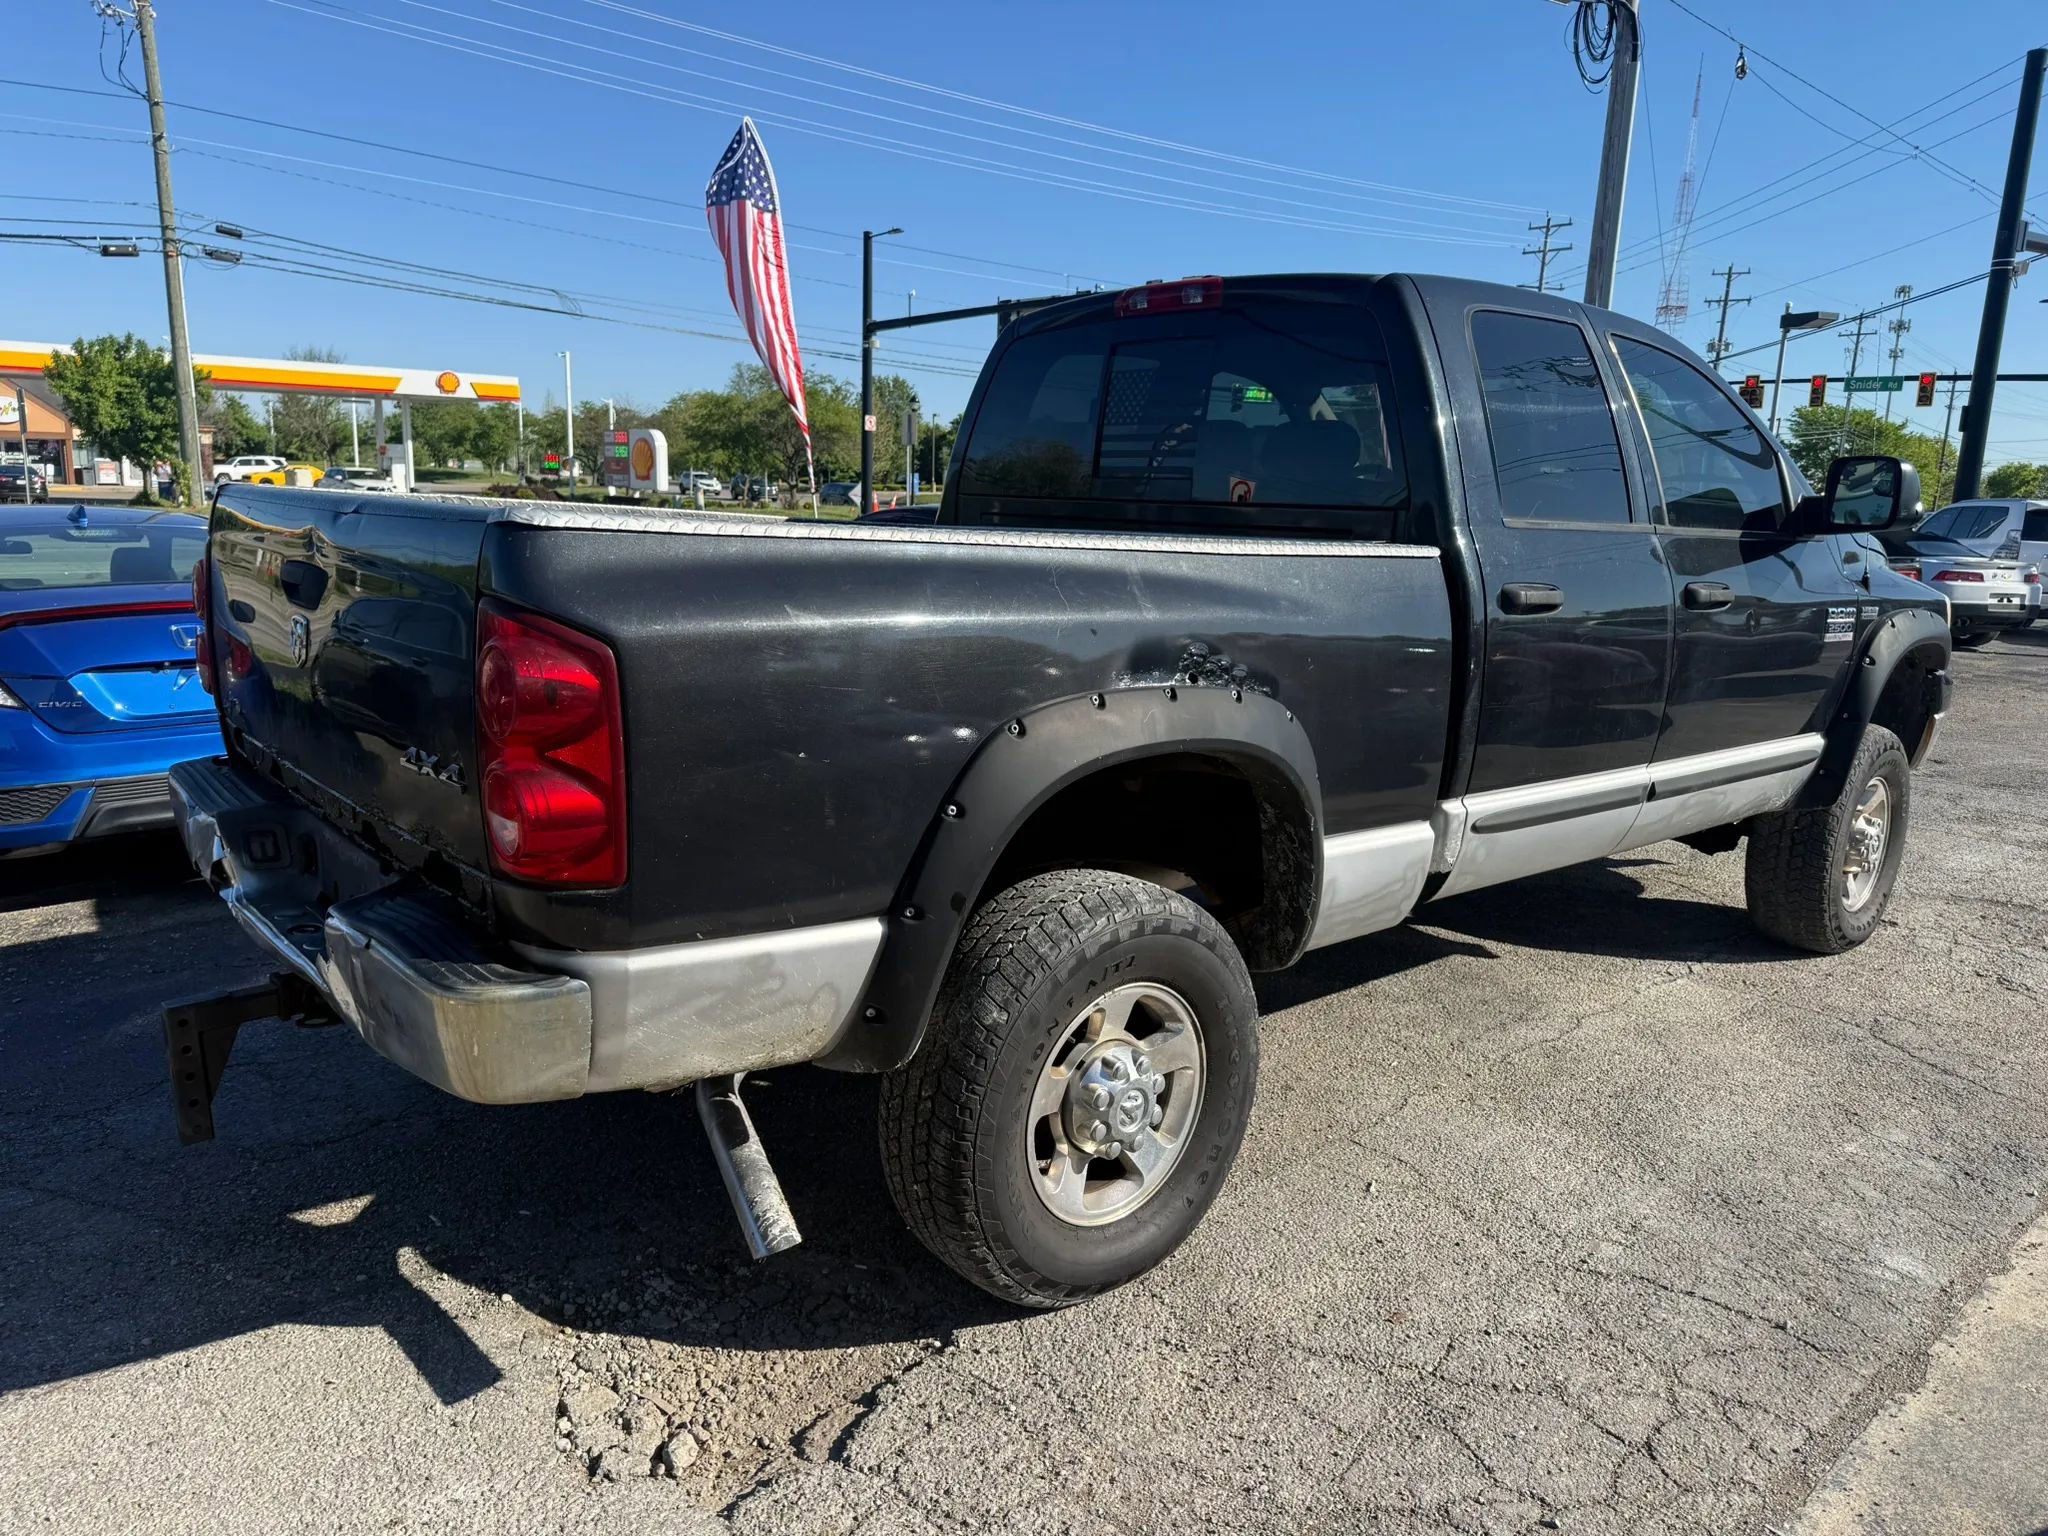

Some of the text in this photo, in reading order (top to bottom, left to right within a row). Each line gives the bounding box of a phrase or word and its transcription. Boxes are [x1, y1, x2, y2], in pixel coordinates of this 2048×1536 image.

[1850, 380, 1898, 390] Snider Rd
[1829, 623, 1853, 633] 2500
